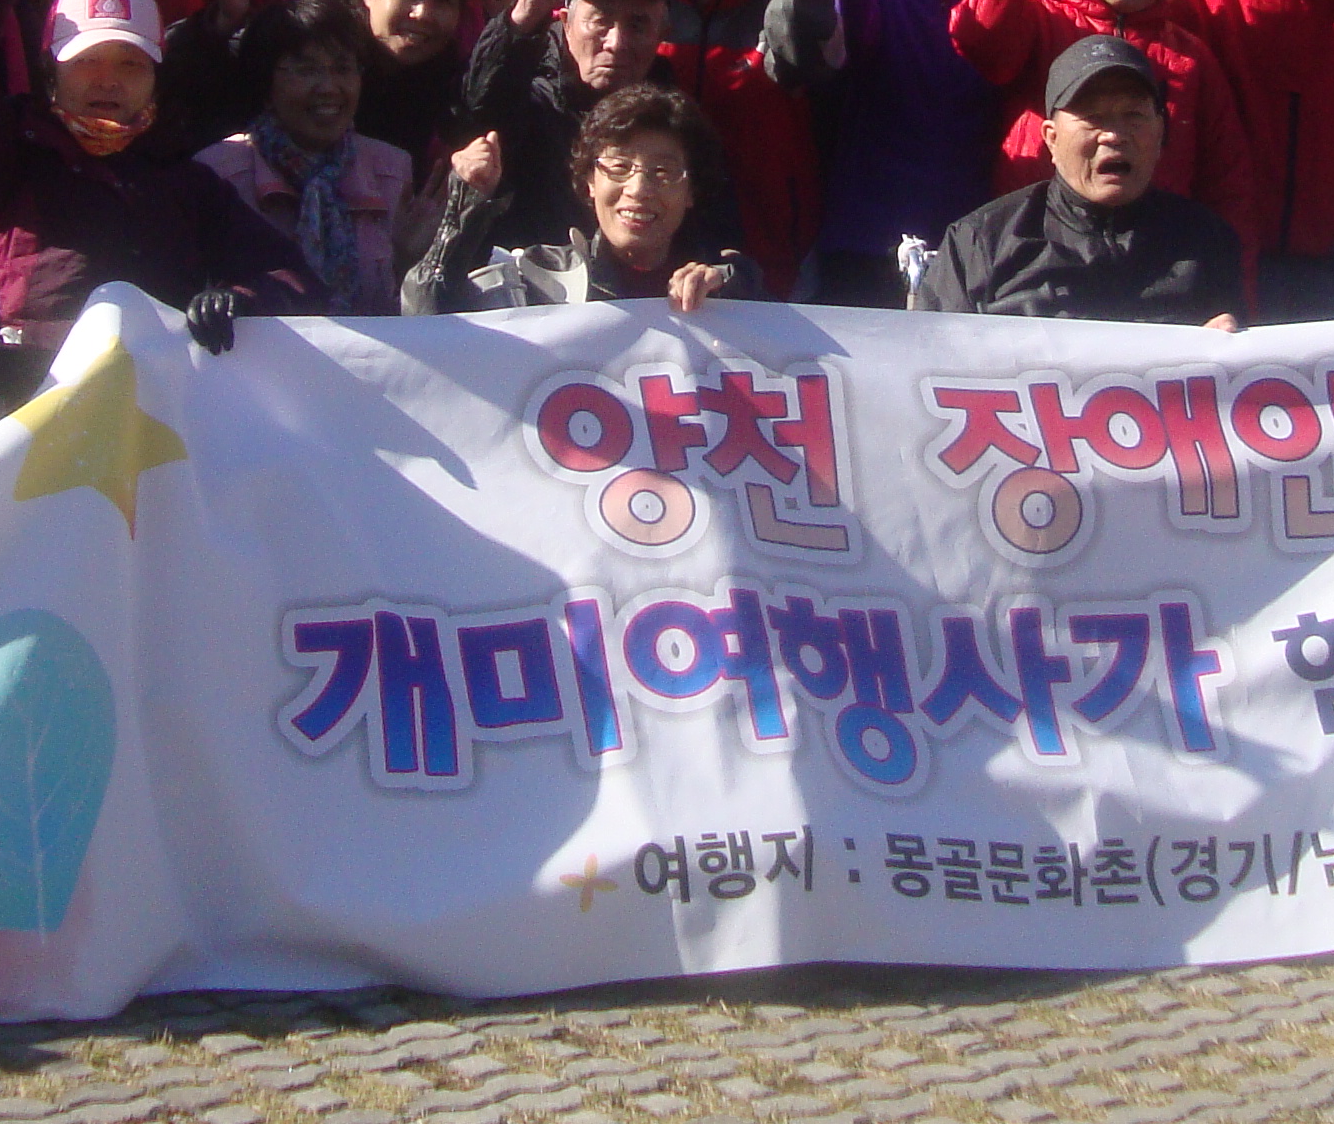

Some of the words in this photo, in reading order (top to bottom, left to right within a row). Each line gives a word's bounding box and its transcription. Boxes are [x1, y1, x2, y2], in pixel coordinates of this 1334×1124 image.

[536, 371, 850, 552] 양천
[291, 587, 1222, 785] 개미여행사가
[633, 824, 815, 903] 여행지
